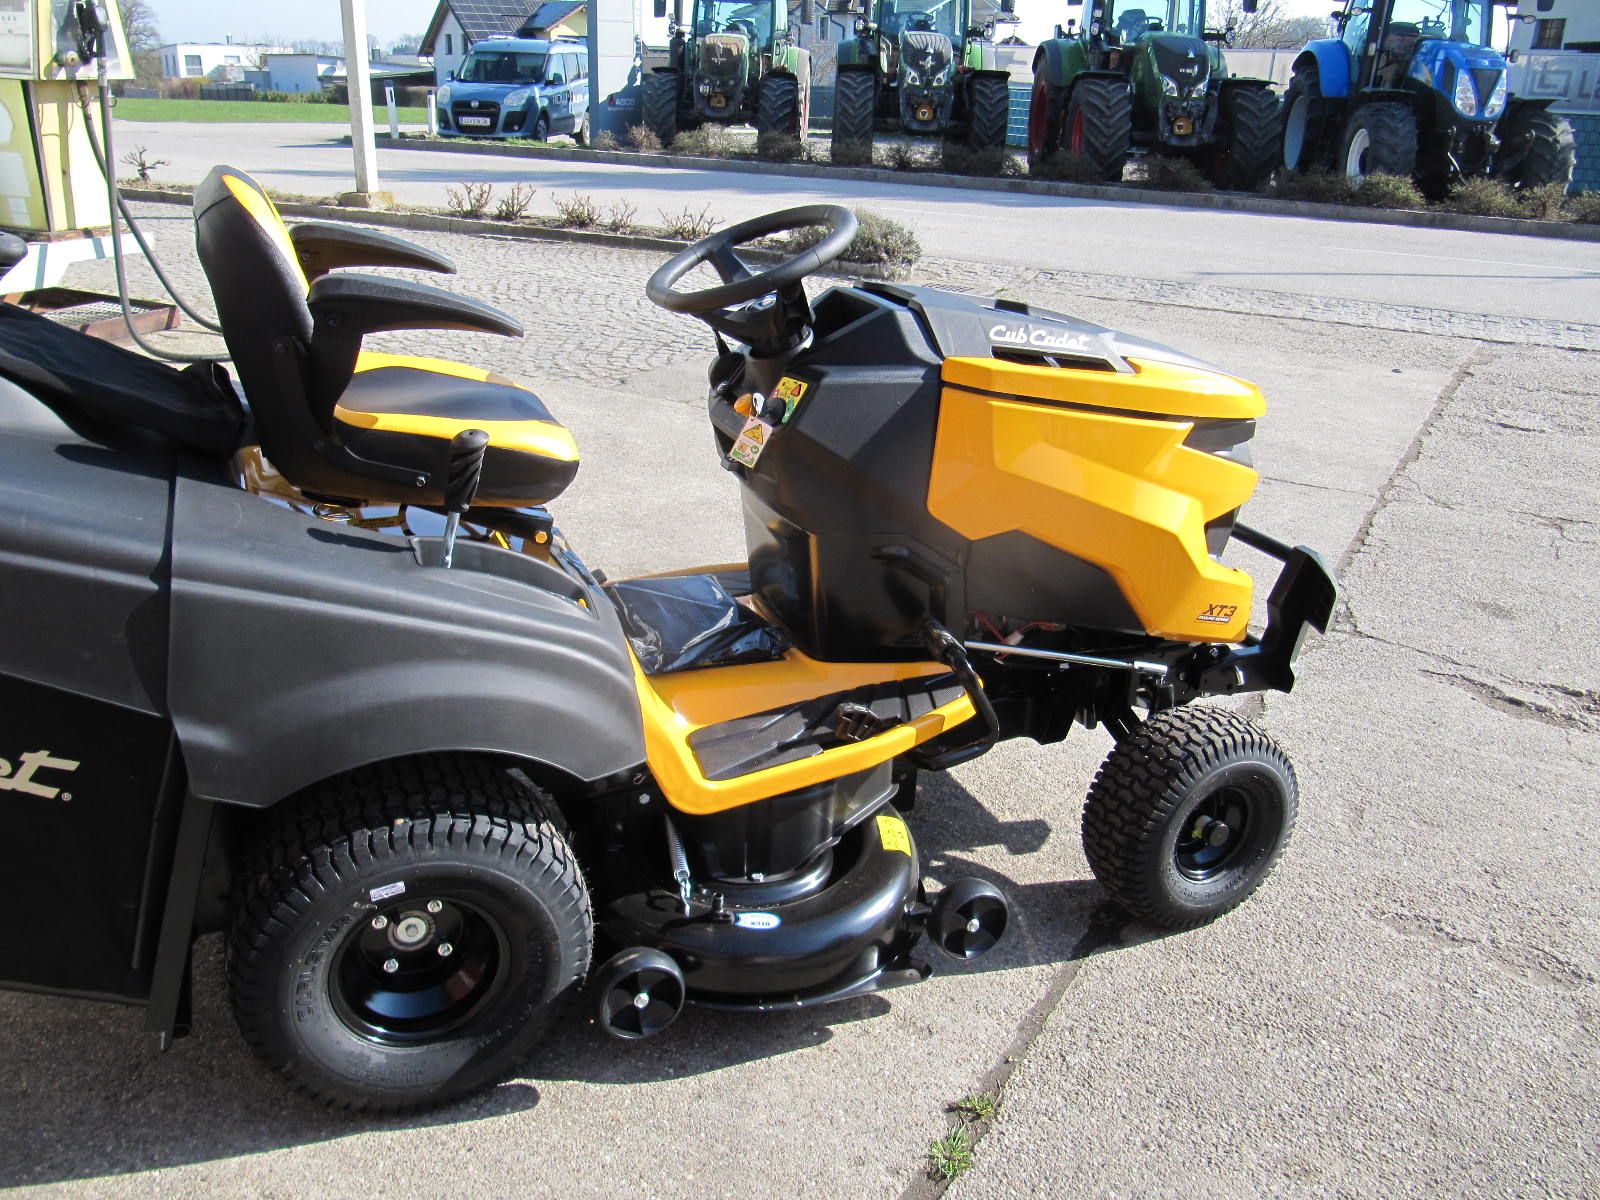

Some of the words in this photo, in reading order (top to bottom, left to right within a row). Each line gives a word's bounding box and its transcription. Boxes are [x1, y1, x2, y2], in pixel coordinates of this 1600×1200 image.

[989, 325, 1028, 344] Cub
[1029, 329, 1090, 351] Cadet
[1202, 603, 1238, 616] XT3
